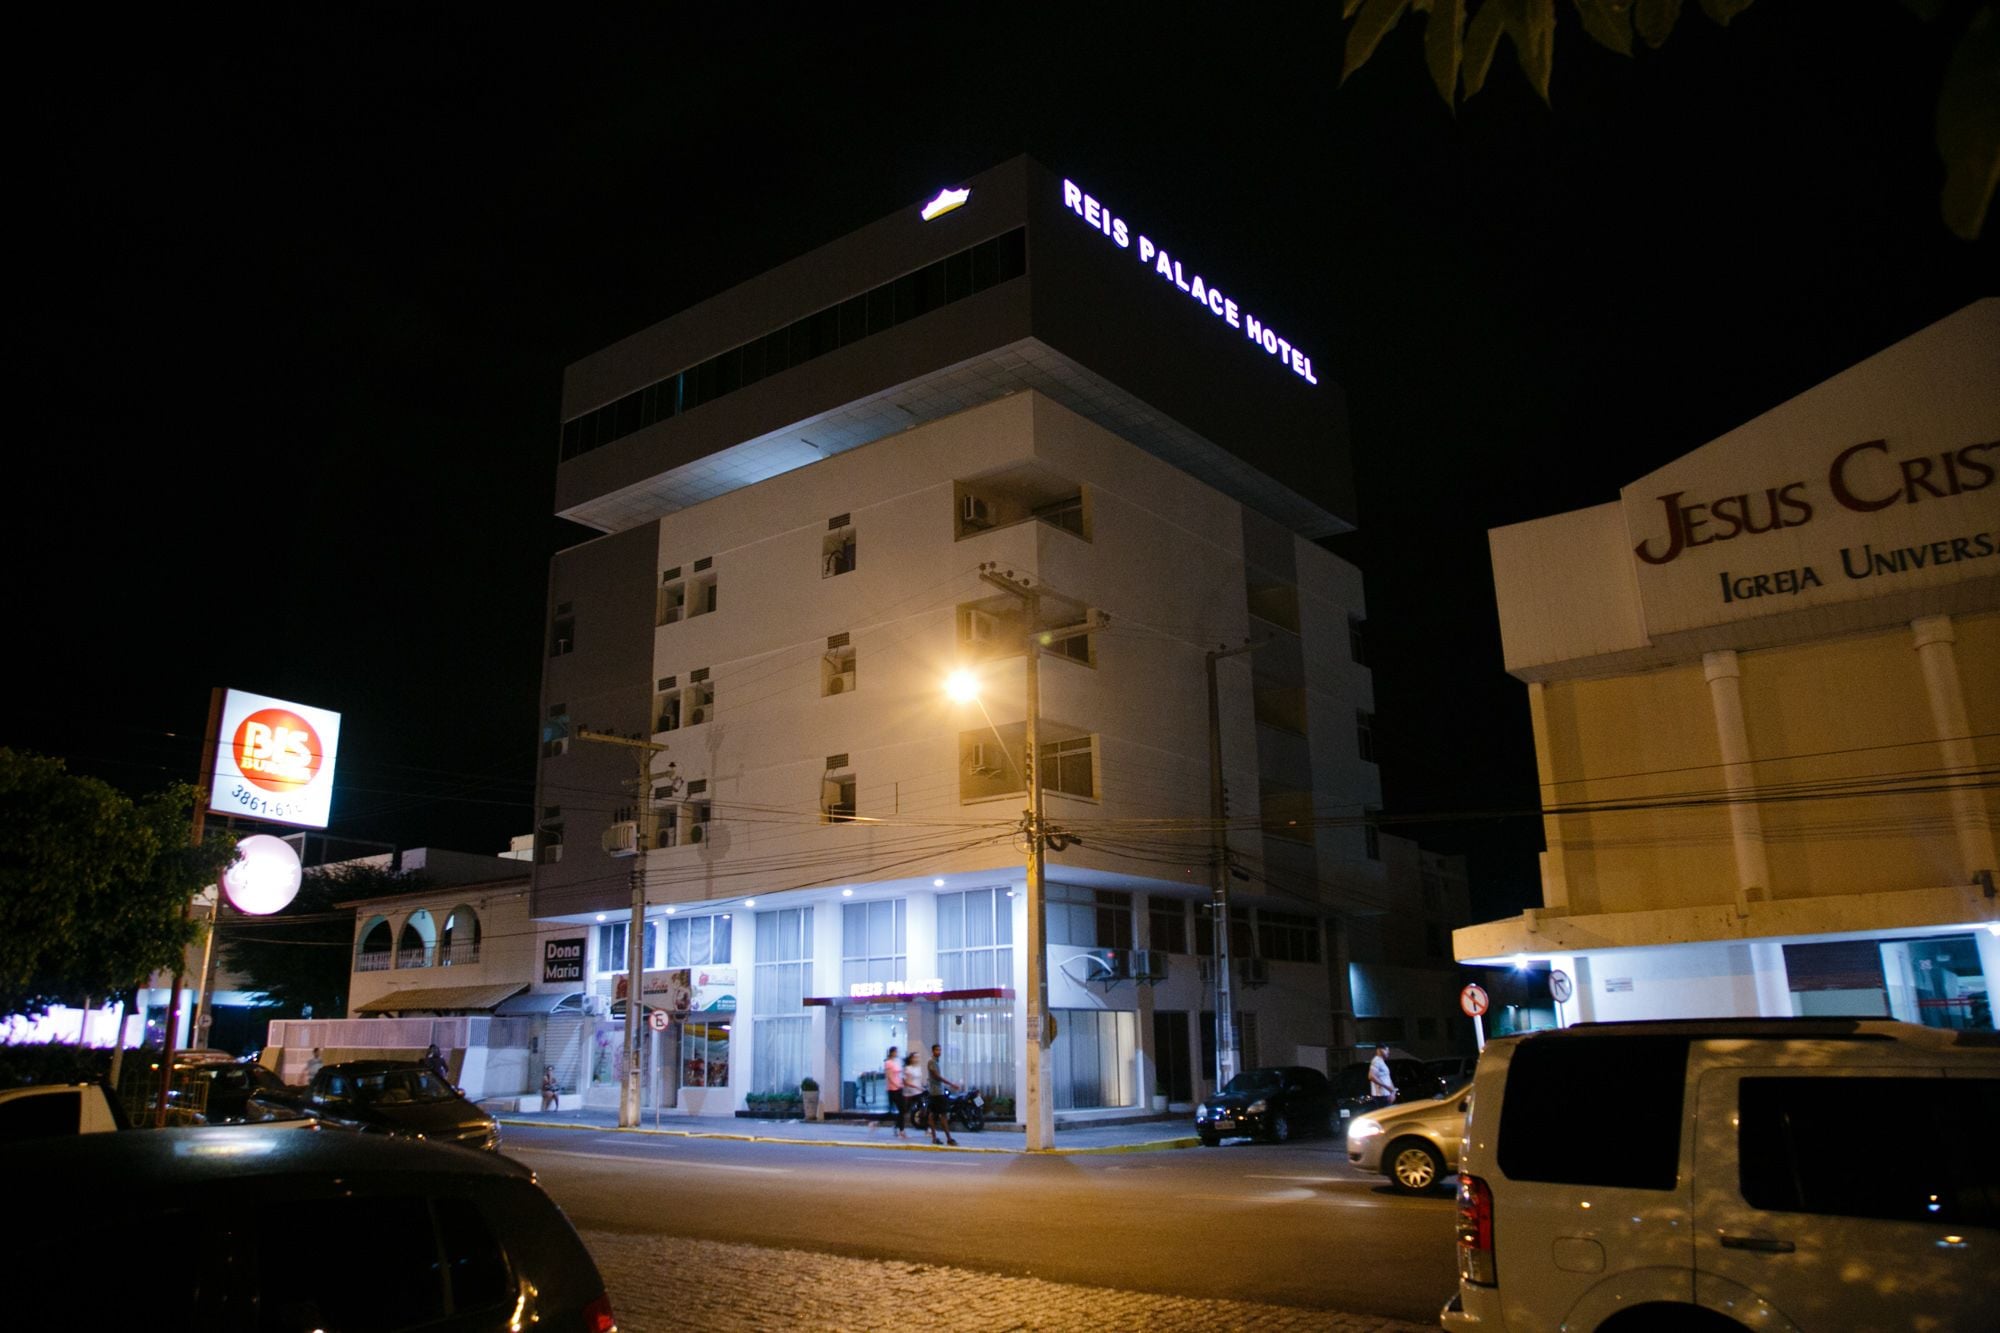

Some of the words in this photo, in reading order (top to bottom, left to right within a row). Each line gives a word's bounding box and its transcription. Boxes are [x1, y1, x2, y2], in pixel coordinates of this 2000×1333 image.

[1064, 178, 1130, 249] REIS
[1138, 234, 1240, 329] PALACE
[1246, 314, 1318, 385] HOTEL
[1634, 481, 1813, 565] JESUS
[1719, 566, 1823, 603] IGREJA
[1839, 532, 2000, 580] UNIVERS
[243, 720, 313, 771] BIS
[546, 963, 580, 979] Maria
[547, 943, 580, 959] Dona
